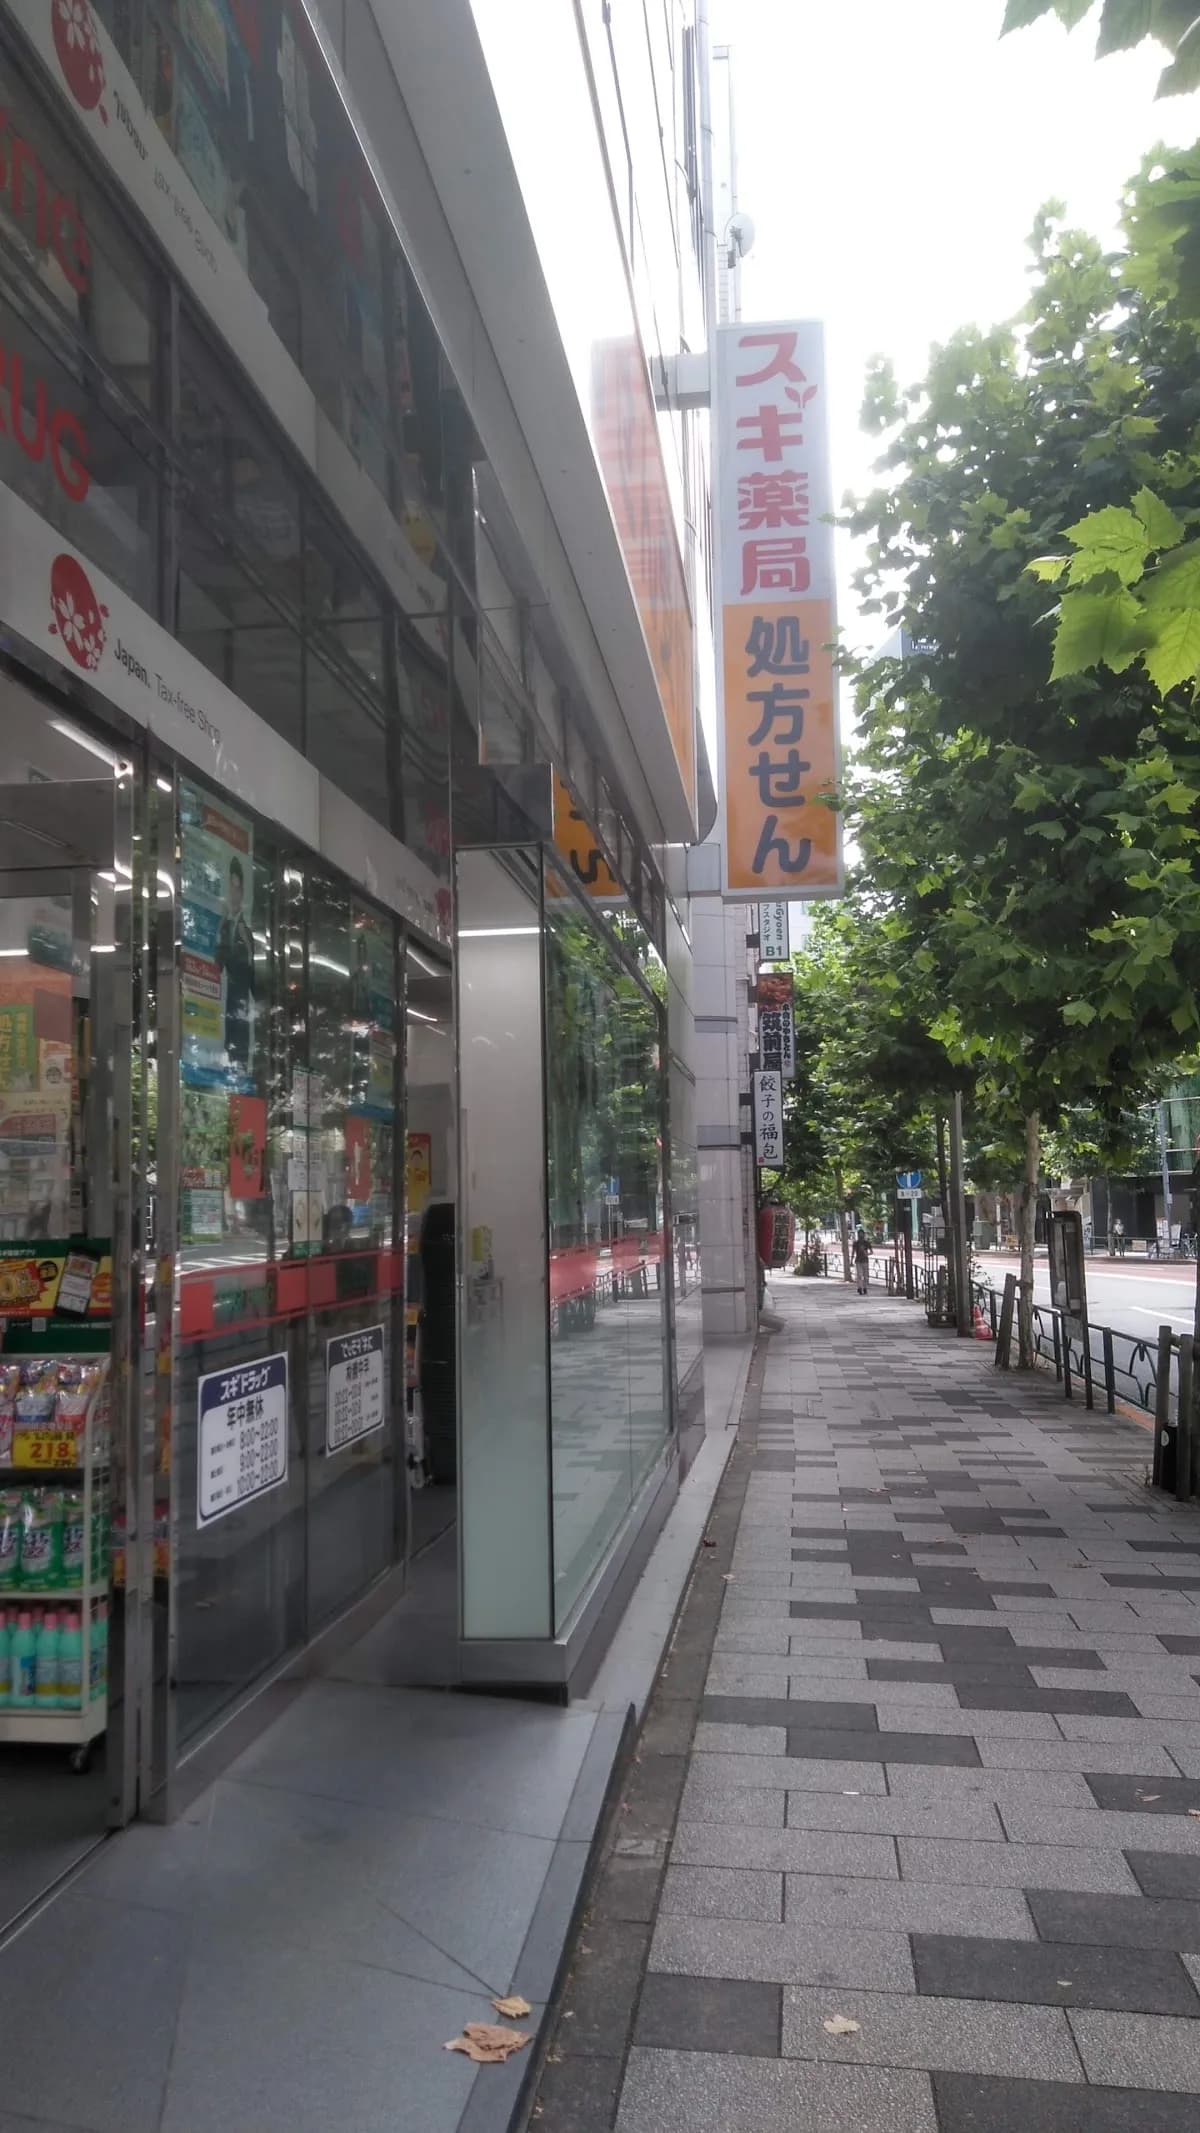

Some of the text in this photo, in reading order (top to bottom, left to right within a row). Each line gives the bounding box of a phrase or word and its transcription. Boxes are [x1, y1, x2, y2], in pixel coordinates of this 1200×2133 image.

[736, 331, 817, 595] スギ薬局
[113, 638, 151, 689] Japan.
[744, 615, 811, 874] 処方せん
[766, 945, 783, 957] B1
[759, 1075, 778, 1160] 餃子の福包
[219, 1366, 271, 1401] スギドラッグ
[226, 1394, 264, 1430] 年中無休
[30, 1442, 69, 1459] 218
